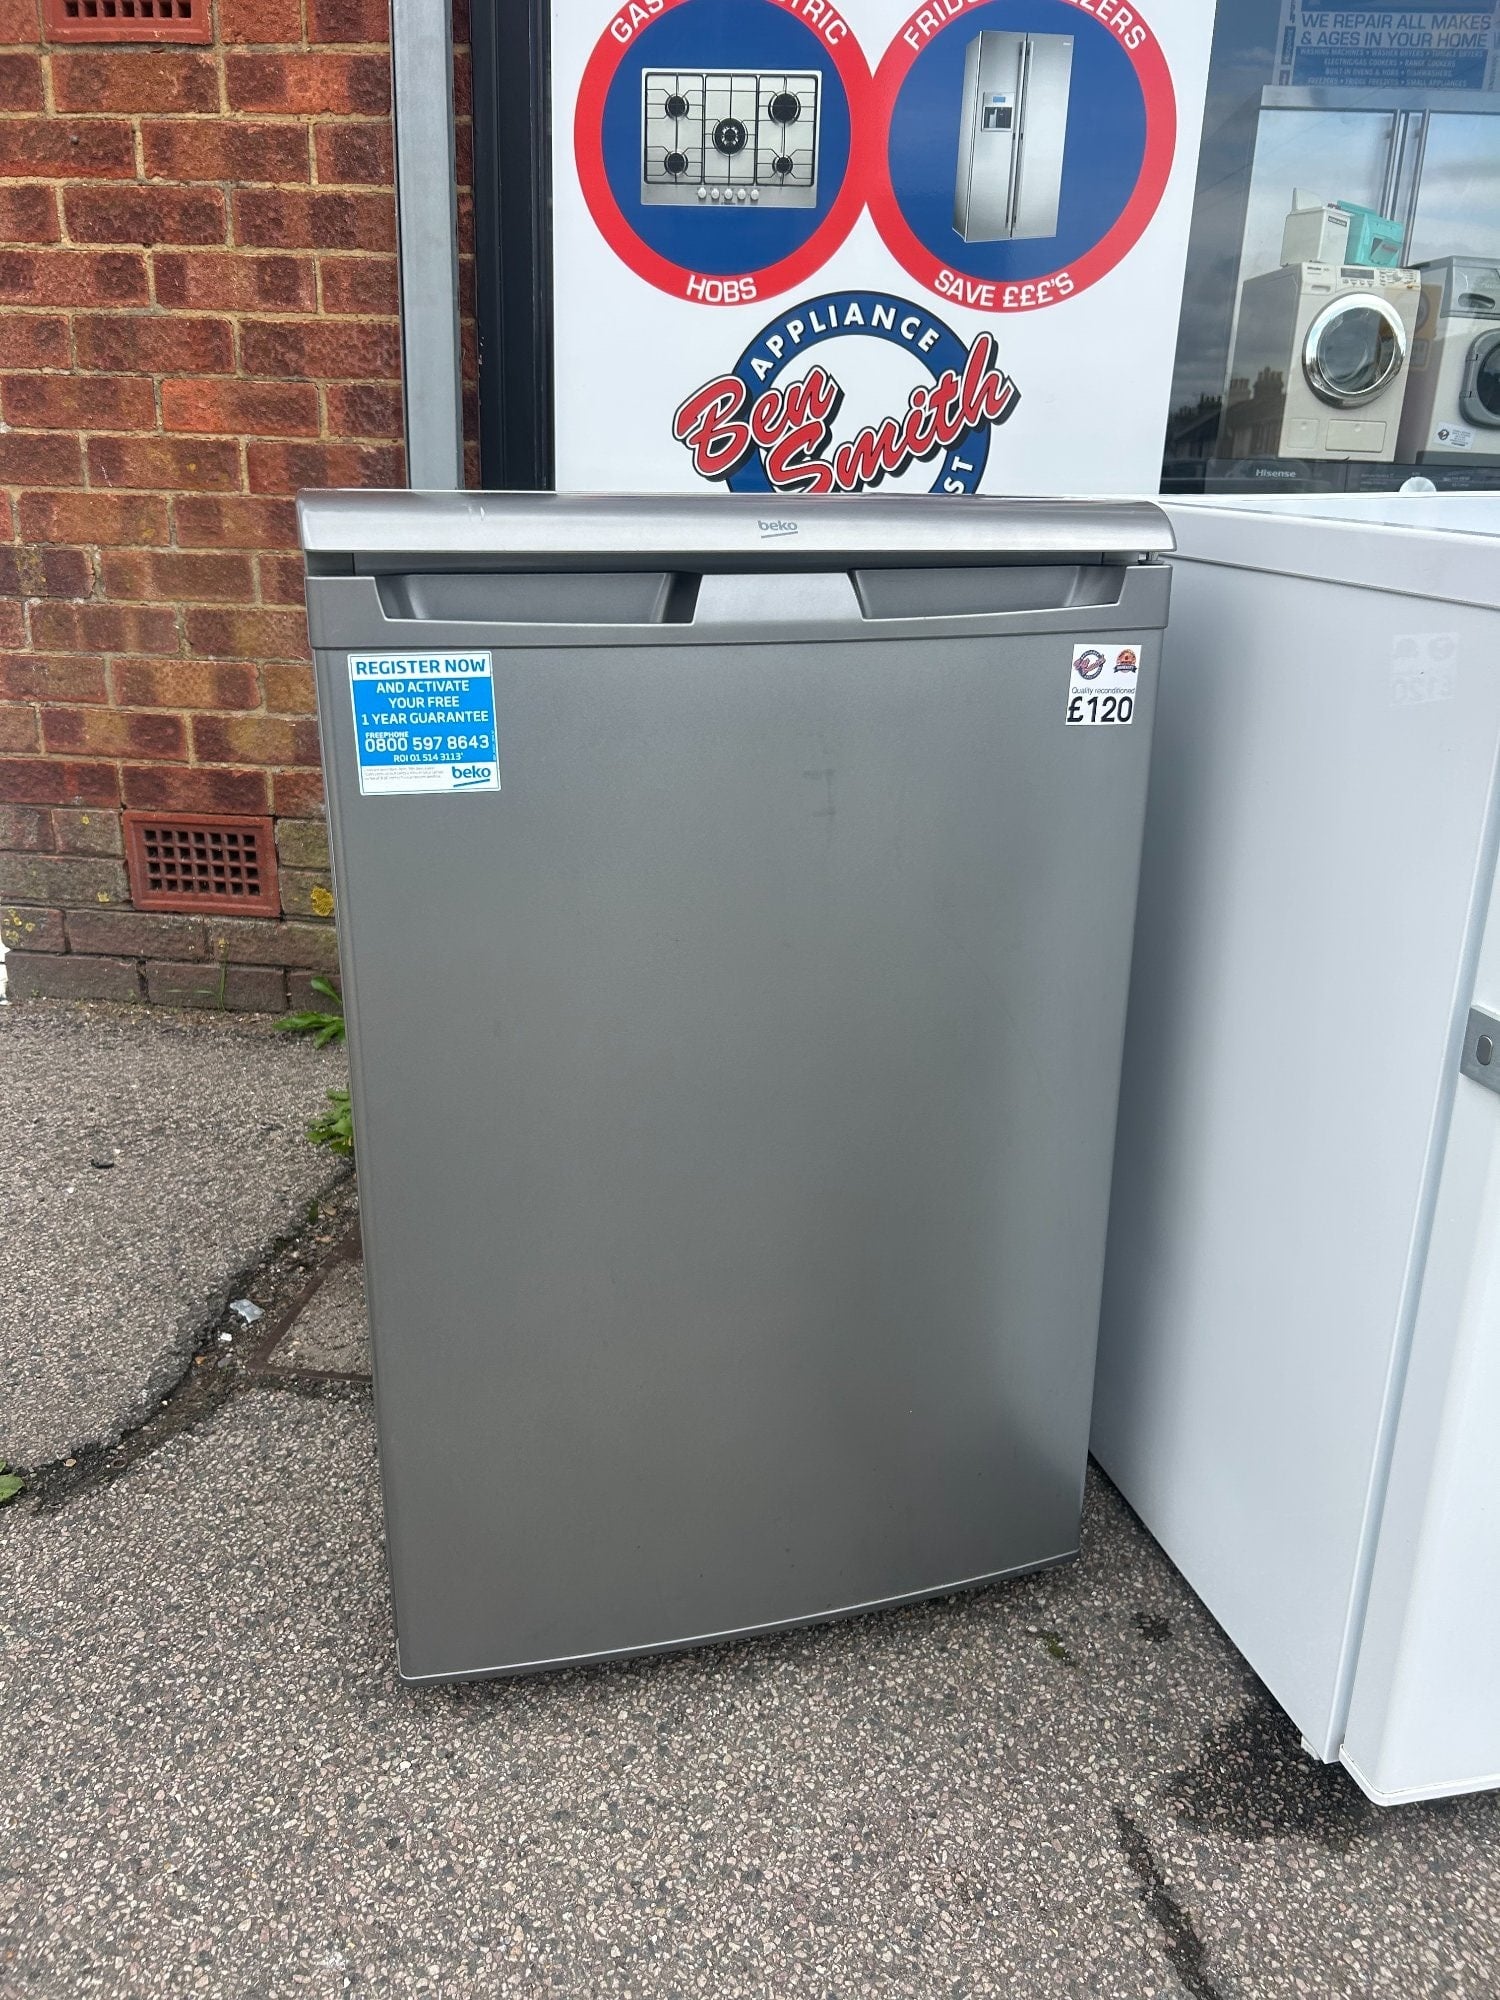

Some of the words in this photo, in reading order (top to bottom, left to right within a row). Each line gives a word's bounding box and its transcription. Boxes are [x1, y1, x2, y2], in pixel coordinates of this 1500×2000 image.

[610, 0, 664, 43] GAS
[903, 0, 970, 51] FRID
[1301, 13, 1329, 28] WE
[1333, 13, 1393, 29] REPAIR
[1396, 14, 1426, 30] ALL
[1431, 14, 1492, 31] MAKES
[1300, 30, 1312, 45] &
[1316, 31, 1360, 46] AGES
[1364, 31, 1383, 47] IN
[1387, 32, 1433, 47] YOUR
[1437, 32, 1488, 48] HOME
[687, 274, 757, 303] HOBS
[934, 269, 995, 308] SAVE
[1002, 272, 1075, 308] £££'S
[750, 302, 940, 381] APPLIANCE
[765, 332, 1018, 493] Smith
[675, 365, 842, 478] Ben
[943, 455, 974, 494] ST
[1255, 468, 1297, 479] Hisense
[757, 519, 798, 532] beko
[355, 659, 440, 675] REGISTER
[445, 658, 486, 673] NOW
[376, 681, 404, 693] AND
[407, 680, 470, 693] ACTIVATE
[1072, 687, 1094, 695] Quality
[388, 697, 425, 708] YOUR
[427, 696, 460, 708] FREE
[1067, 696, 1133, 722] £120
[361, 714, 370, 725] 1
[372, 713, 408, 725] YEAR
[409, 711, 489, 724] GUARANTEE
[365, 731, 409, 739] FREEPHONE
[365, 738, 408, 752] 0800
[412, 736, 443, 751] 597
[447, 735, 489, 749] 8643
[393, 754, 409, 763] ROI
[409, 753, 421, 762] 01
[422, 753, 438, 762] 514
[452, 765, 491, 779] beko
